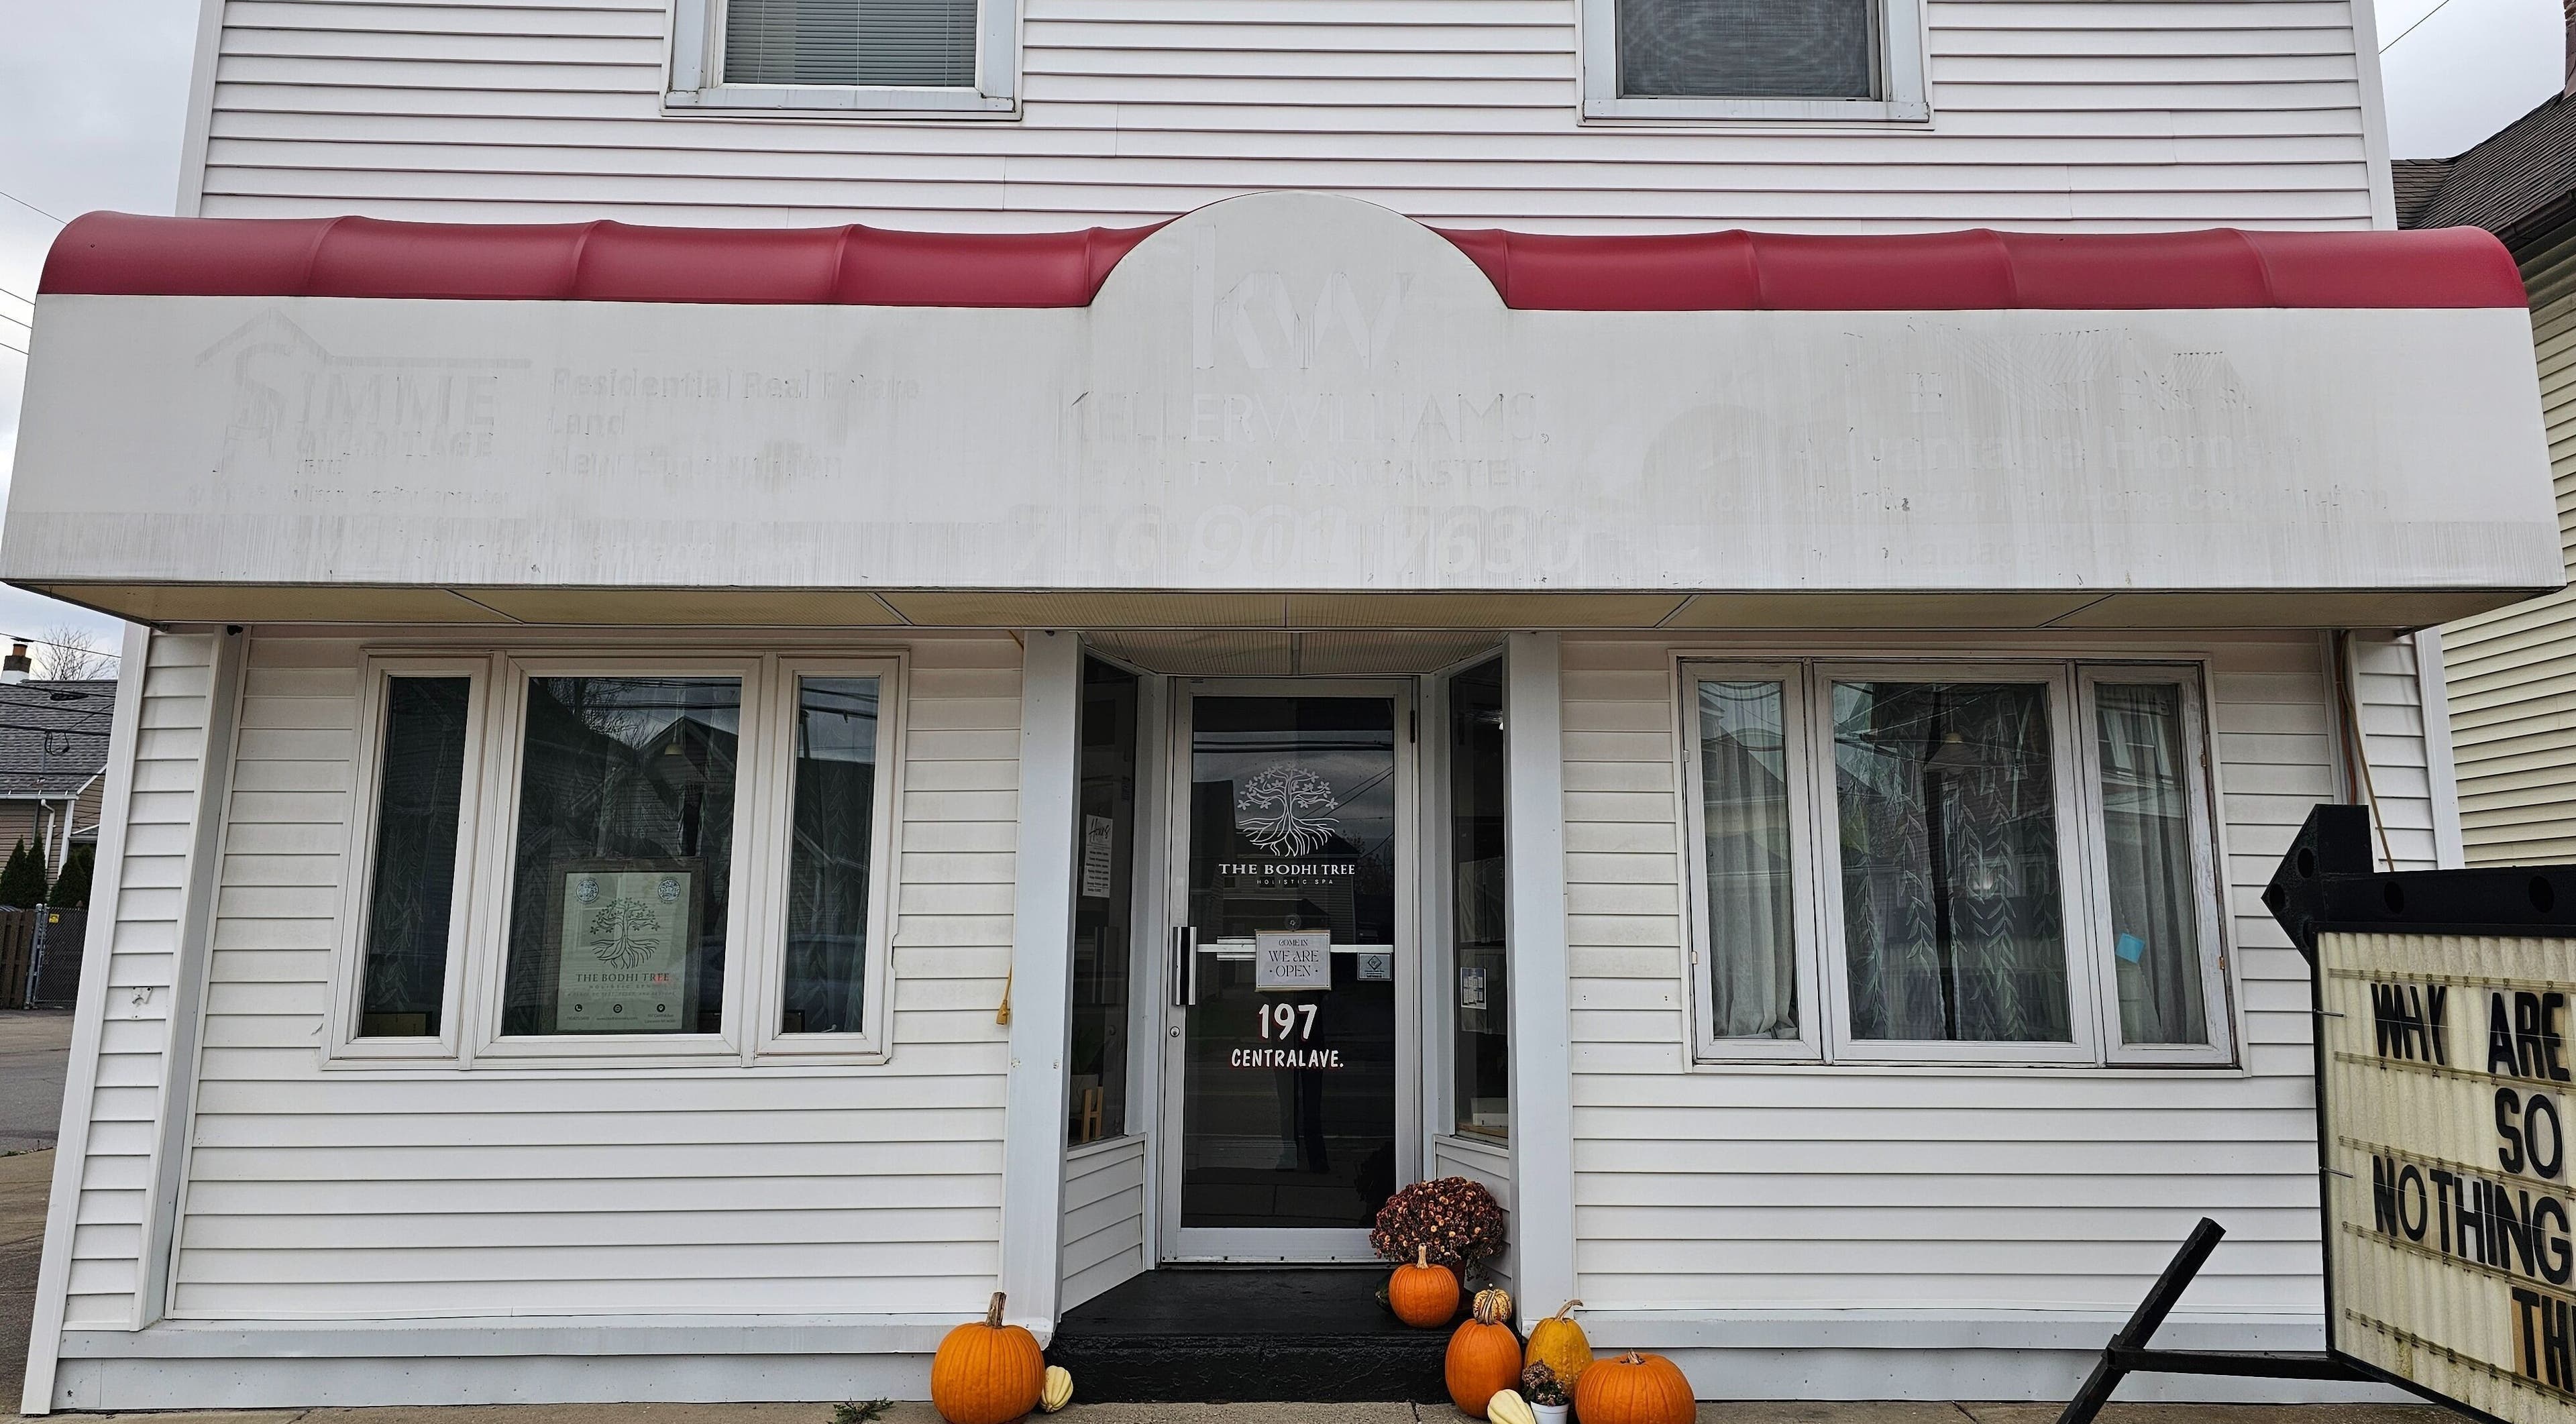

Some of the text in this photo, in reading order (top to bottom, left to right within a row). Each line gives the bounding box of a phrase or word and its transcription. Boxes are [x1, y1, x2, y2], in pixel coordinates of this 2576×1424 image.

[1218, 863, 1356, 875] THE BODHI TREE
[1269, 950, 1319, 963] WE ARE
[1275, 965, 1311, 977] OPEN
[576, 972, 669, 982] THE BODHI TREE
[1258, 1003, 1318, 1040] 197
[2370, 983, 2571, 1082] WHY ARE
[2494, 1087, 2563, 1180] SO
[2372, 1154, 2572, 1285] NOTHING
[2512, 1286, 2576, 1393] TH
